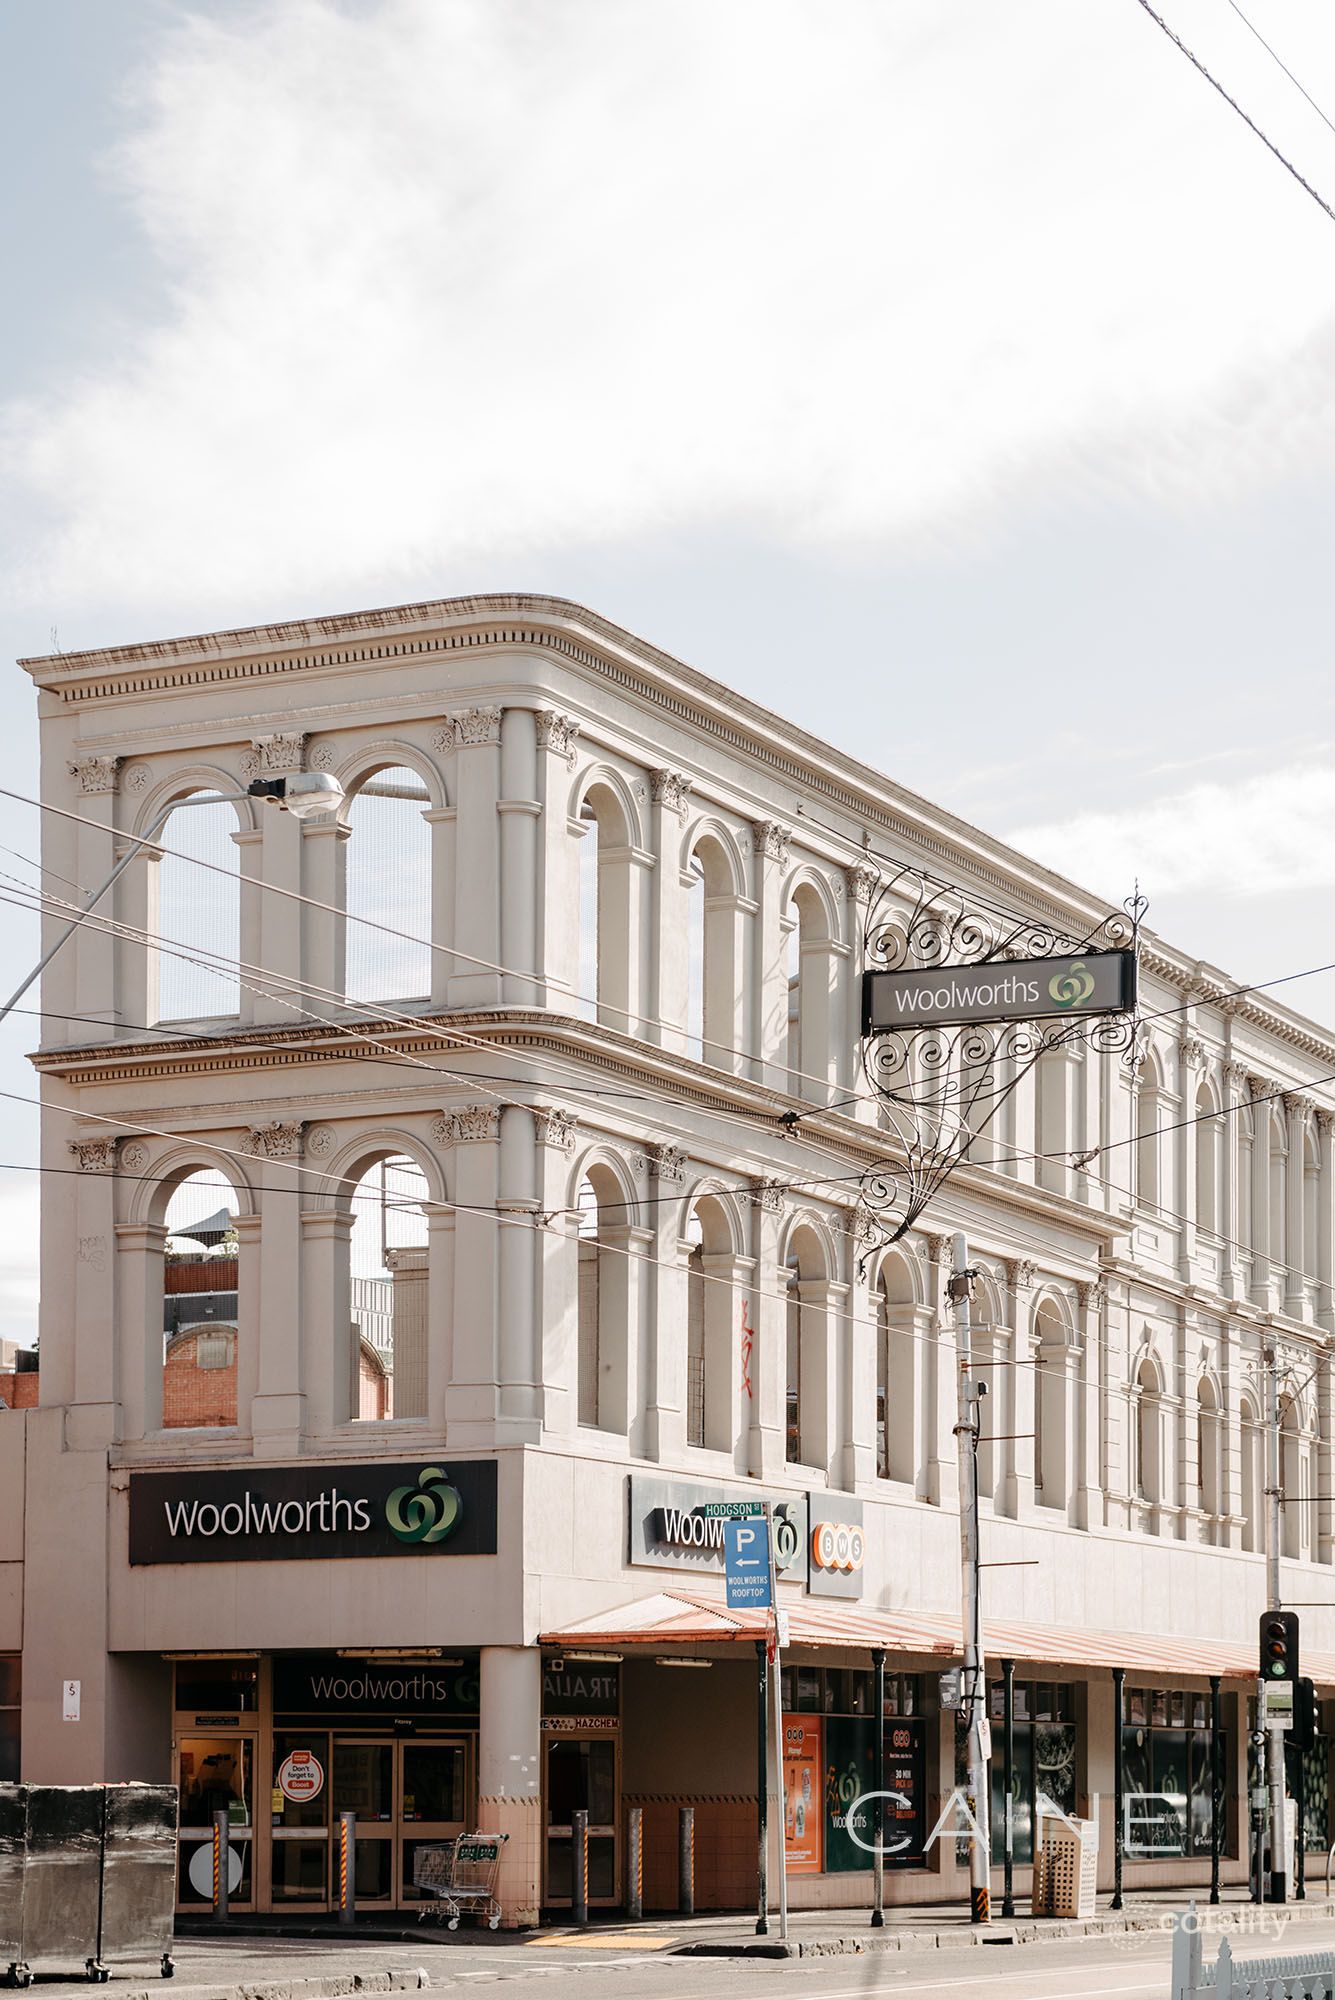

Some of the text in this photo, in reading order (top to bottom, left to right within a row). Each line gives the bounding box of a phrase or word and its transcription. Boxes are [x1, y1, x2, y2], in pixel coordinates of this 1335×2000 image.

[894, 975, 1040, 1012] Woolworths
[164, 1488, 371, 1536] Woolworths
[706, 1503, 753, 1516] HODGSON
[736, 1528, 755, 1552] P
[728, 1575, 768, 1585] WOOLWORTHS
[731, 1588, 765, 1598] ROOFTOP
[310, 1673, 447, 1701] Woolworths
[575, 1718, 618, 1729] HAZCHEM
